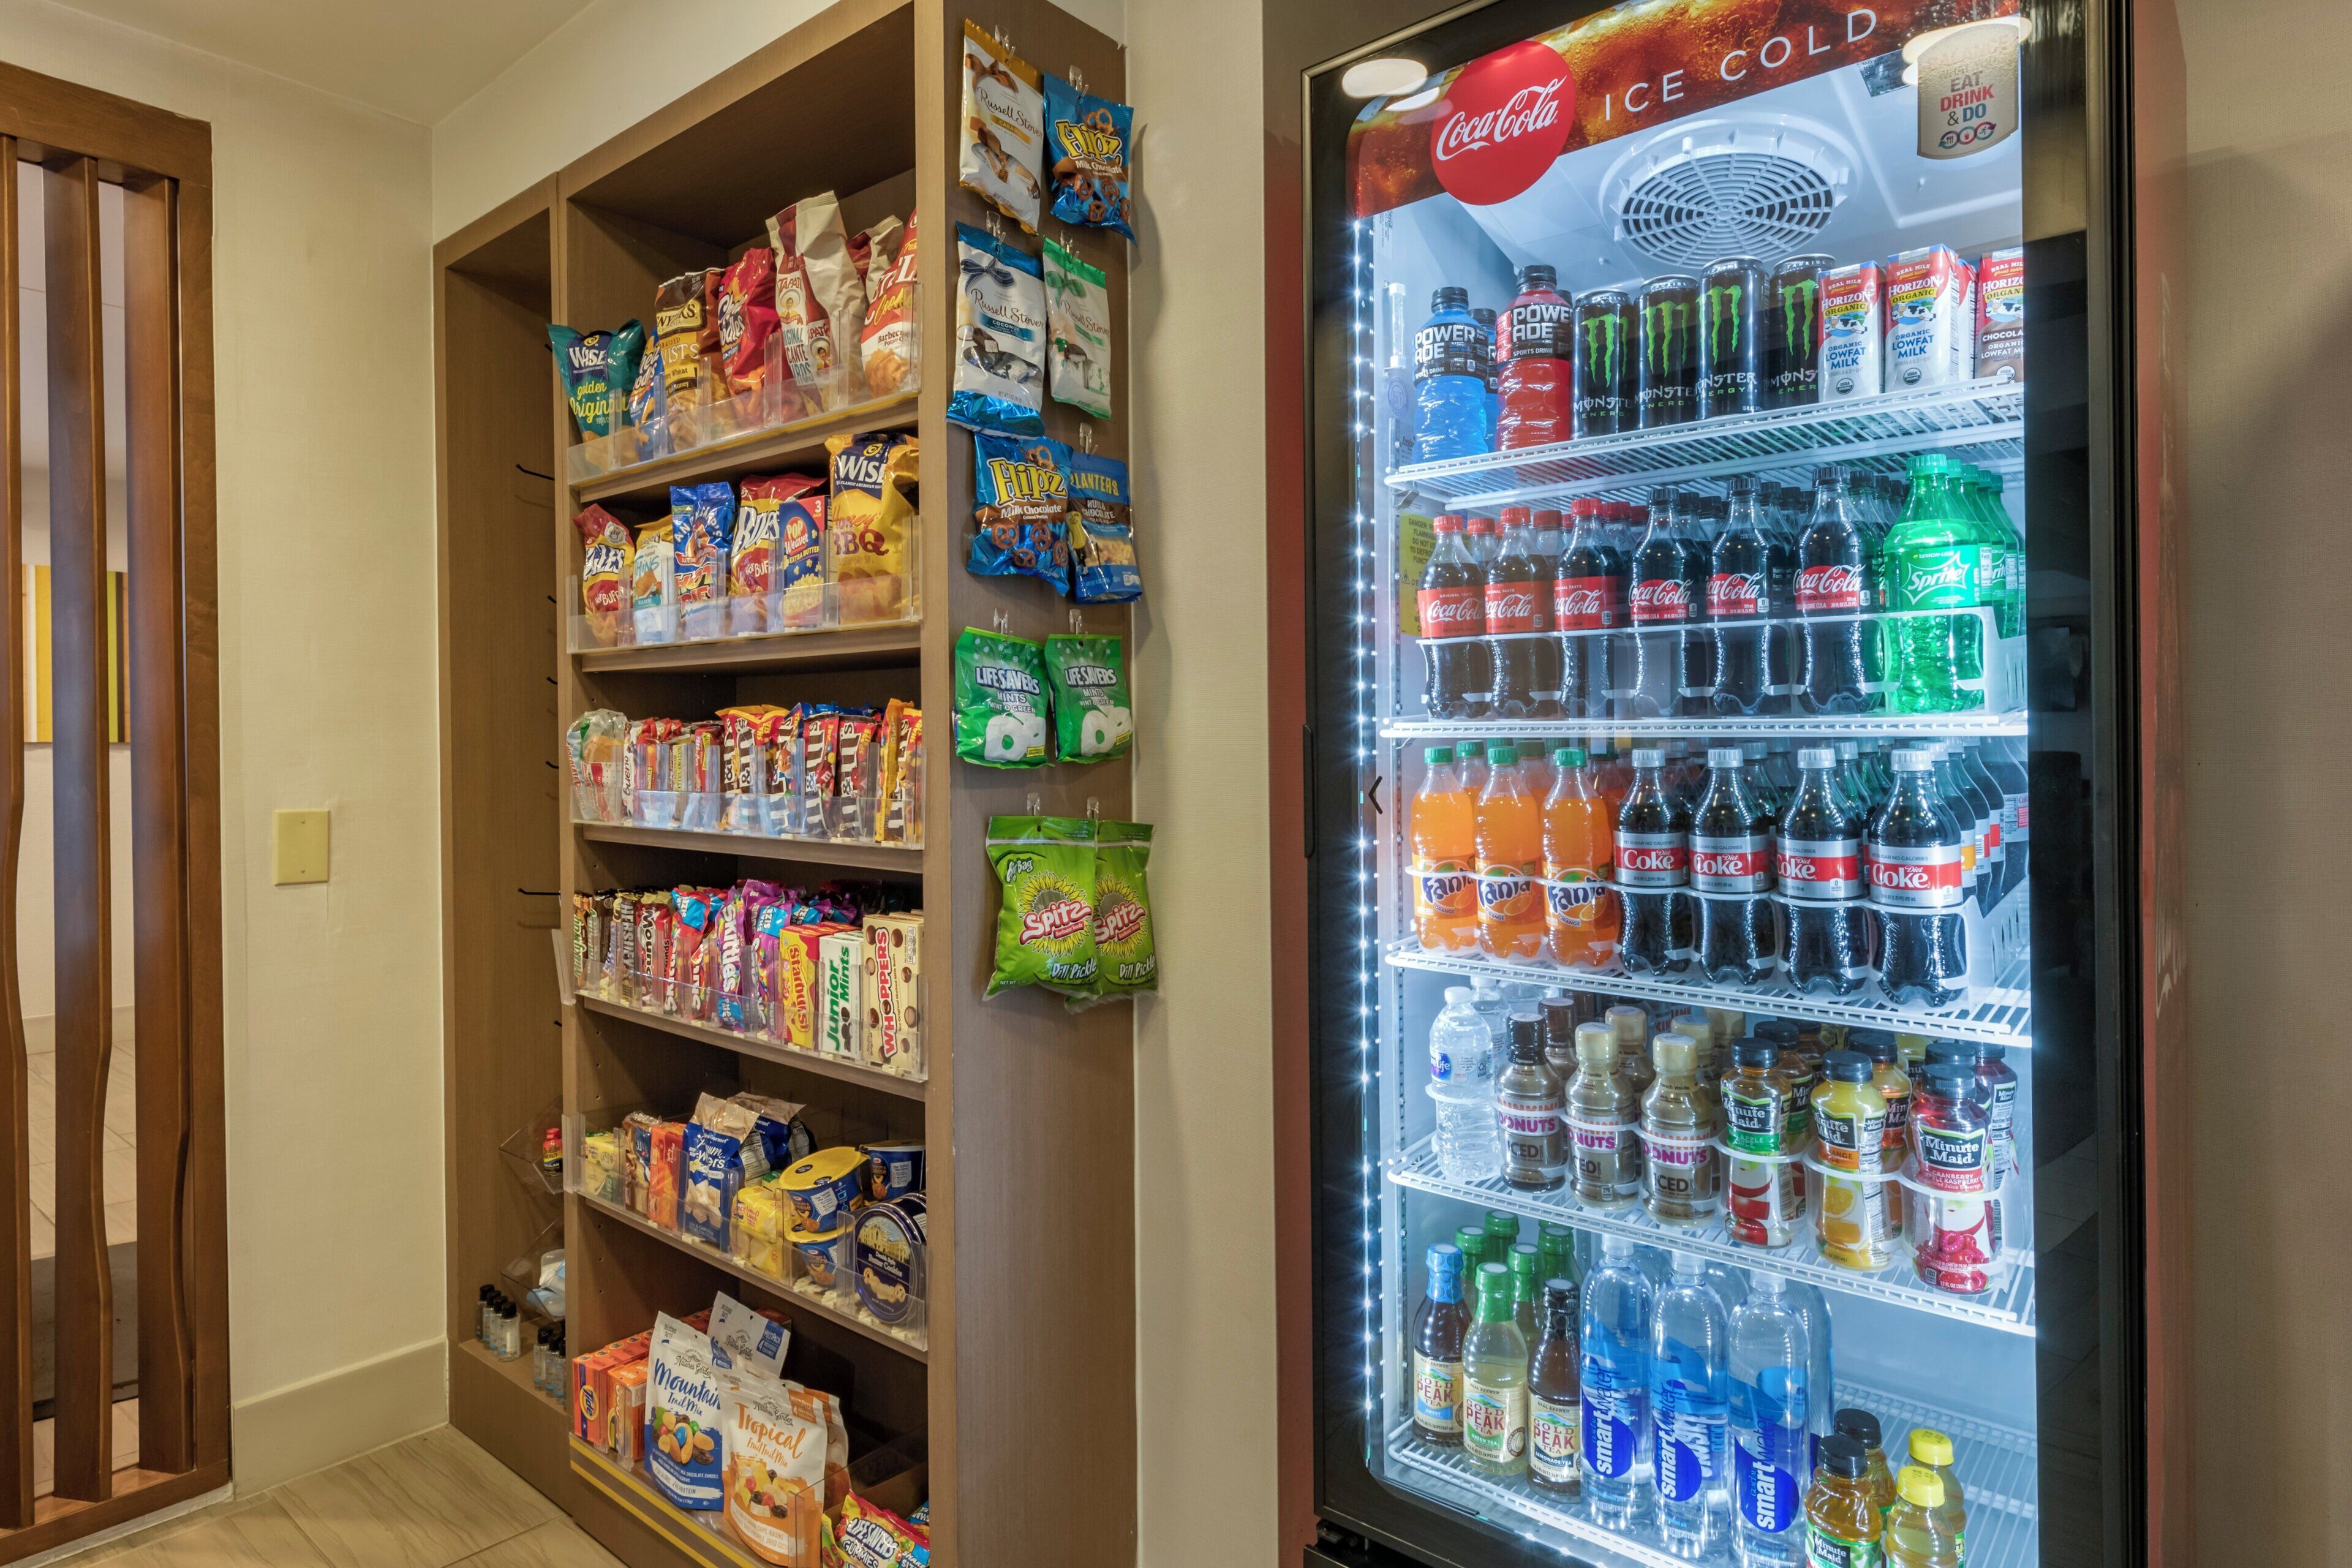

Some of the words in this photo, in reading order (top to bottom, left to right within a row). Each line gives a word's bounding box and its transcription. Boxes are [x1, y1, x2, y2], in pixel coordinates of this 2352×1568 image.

[1605, 69, 1684, 121] ICE
[1720, 9, 1877, 81] COLD
[1940, 83, 1995, 112] DRINK
[978, 86, 1014, 121] Russell
[1014, 110, 1043, 139] Stover
[1436, 75, 1567, 161] Coca-Cola
[1947, 111, 1959, 126] &
[1963, 103, 1986, 123] DO
[1055, 119, 1123, 166] Flipz
[1076, 159, 1091, 170] Milk
[1091, 160, 1123, 174] Chocolate
[1896, 267, 1913, 276] REAL
[1991, 265, 2009, 273] REAL
[1828, 282, 1844, 290] REAL
[1888, 276, 1942, 297] HORIZON
[1821, 292, 1871, 311] HORIZON
[1892, 288, 1935, 304] ORGANIC
[971, 288, 1009, 318] Russell
[1010, 308, 1044, 329] Stover
[1825, 303, 1866, 317] ORGANIC
[1414, 325, 1476, 349] POWER
[1513, 322, 1553, 342] ADE
[1895, 329, 1930, 340] ORGANIC
[1513, 347, 1534, 356] SPORTS
[1828, 341, 1862, 352] ORGANIC
[1891, 335, 1934, 351] LOWFAT
[1898, 346, 1926, 358] MILK
[1414, 342, 1445, 366] ADE
[1825, 347, 1866, 362] LOWFAT
[1981, 349, 2010, 359] LOWFAT
[672, 368, 688, 377] Wheat
[1830, 358, 1859, 371] MILK
[578, 381, 606, 399] golden
[987, 457, 1068, 507] Flipz
[815, 500, 821, 513] 3
[1001, 506, 1022, 518] Milk
[1024, 505, 1062, 514] Chocolate
[1082, 507, 1115, 518] CHOCOLATE
[786, 522, 803, 539] POP
[785, 533, 809, 553] Weaver
[789, 551, 804, 563] EXTRA
[1793, 564, 1866, 594] Coca-Cola
[1908, 565, 1962, 591] Sprite
[1629, 579, 1694, 606] Coca-Cola
[997, 691, 1027, 703] MINTS
[1083, 688, 1105, 697] MINTS
[1012, 704, 1036, 714] GREEN
[1017, 858, 1033, 873] Bag
[1624, 850, 1674, 870] Coke
[1693, 853, 1743, 875] Coke
[1873, 864, 1928, 888] Coke
[1434, 905, 1455, 914] ORANGE
[1020, 900, 1093, 944] Spitz
[1559, 916, 1581, 926] ORANGE
[643, 909, 656, 992] Mounds
[839, 946, 850, 1003] Mints
[1051, 962, 1069, 978] Dill
[1070, 957, 1097, 979] Pickle
[1119, 962, 1133, 978] Dill
[1135, 954, 1155, 978] Pickle
[827, 959, 840, 1052] Junior
[1499, 1117, 1556, 1133] DONUTS
[1508, 1139, 1540, 1158] ICED
[1643, 1140, 1707, 1165] DONUTS
[1926, 1137, 1979, 1157] Minute
[1654, 1172, 1689, 1191] ICED
[1932, 1170, 1973, 1180] CRANBERRY
[654, 1358, 721, 1410] Mountain
[1417, 1373, 1453, 1389] GOLD
[1417, 1381, 1453, 1403] PEAK
[583, 1387, 594, 1419] Tide
[686, 1398, 703, 1417] Mix
[1424, 1398, 1442, 1407] TEA
[1466, 1399, 1504, 1415] GOLD
[1466, 1407, 1505, 1430] PEAK
[1533, 1418, 1575, 1434] GOLD
[735, 1402, 807, 1460] Tropical
[1471, 1434, 1485, 1442] GREEN
[1474, 1424, 1493, 1435] TEA
[1533, 1425, 1575, 1450] PEAK
[1754, 1412, 1775, 1463] water
[1542, 1446, 1562, 1455] TEA
[1593, 1407, 1613, 1475] smart
[1536, 1452, 1562, 1463] LEMONADE
[1659, 1430, 1676, 1499] smart
[679, 1486, 696, 1494] PROTEIN
[1753, 1461, 1775, 1530] smart
[843, 1539, 878, 1568] GUMMIES
[1814, 1536, 1846, 1557] Minute
[1817, 1550, 1842, 1564] Maid
